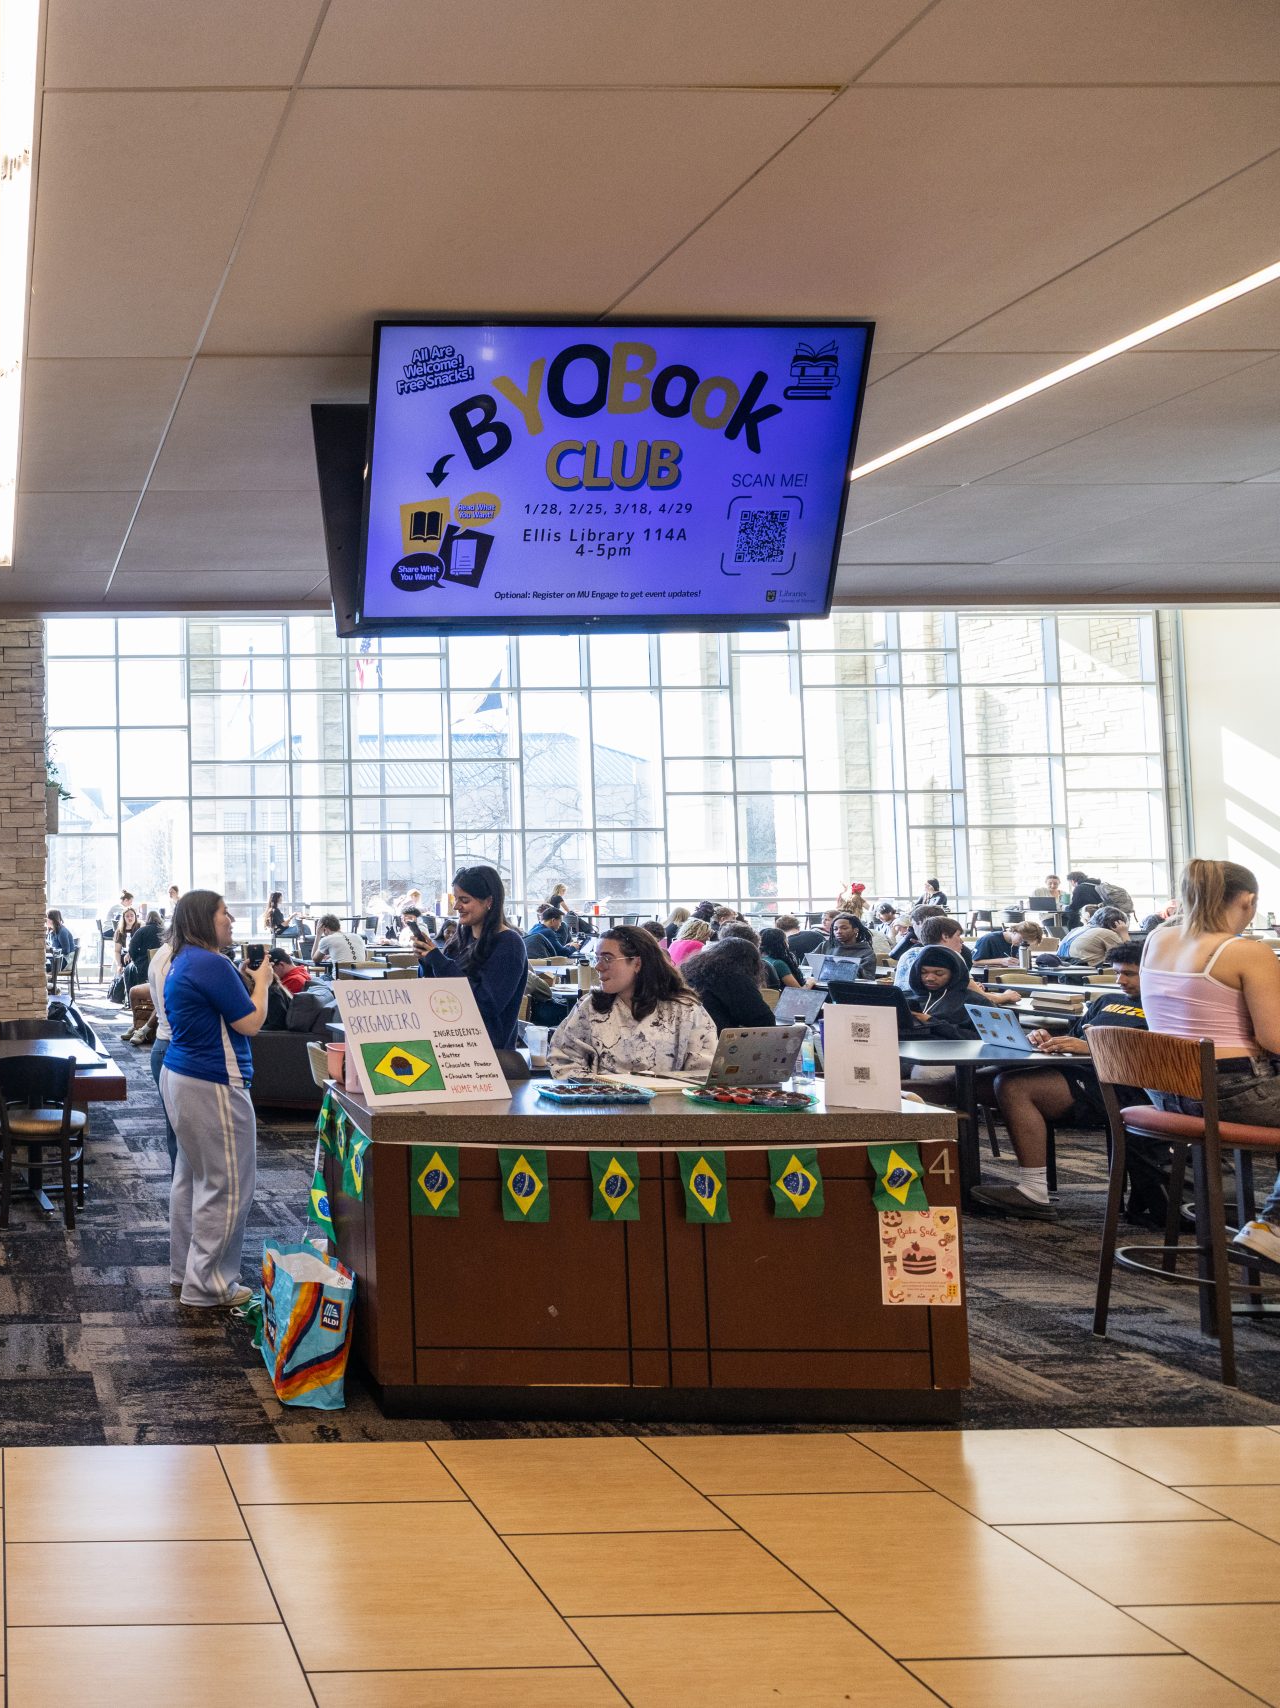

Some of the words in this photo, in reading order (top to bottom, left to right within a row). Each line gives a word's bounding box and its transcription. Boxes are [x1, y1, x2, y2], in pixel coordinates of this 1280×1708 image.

[412, 347, 430, 363] All
[431, 345, 454, 360] Are
[403, 354, 464, 378] Welcome!
[397, 380, 425, 394] Free
[426, 366, 474, 388] Snacks!
[449, 342, 783, 471] BYOBook
[545, 439, 682, 489] CLUB
[731, 473, 776, 488] SCAN
[780, 473, 808, 488] ME!
[523, 503, 562, 516] 1/28,
[569, 503, 607, 516] 2/25,
[614, 503, 652, 515] 3/18,
[658, 503, 693, 515] 4/29
[523, 528, 562, 542] Ellis
[569, 528, 635, 544] Library
[643, 528, 687, 542] 114A
[575, 544, 632, 560] 4-5pm
[398, 565, 420, 573] Share
[420, 565, 440, 573] What
[400, 573, 413, 581] You
[494, 591, 531, 600] Optional:
[532, 591, 564, 600] Register
[577, 591, 590, 599] MU
[591, 591, 619, 600] Engage
[631, 591, 643, 600] get
[667, 590, 701, 600] updates!
[346, 989, 412, 1008] BRAZILIAN
[349, 1012, 421, 1035] BRIGADEIRO
[433, 1028, 482, 1038] INGREDIENTS:
[928, 1148, 955, 1185] 4
[897, 1226, 918, 1239] Bake
[920, 1225, 938, 1238] Sale
[322, 1316, 339, 1327] ALDI
